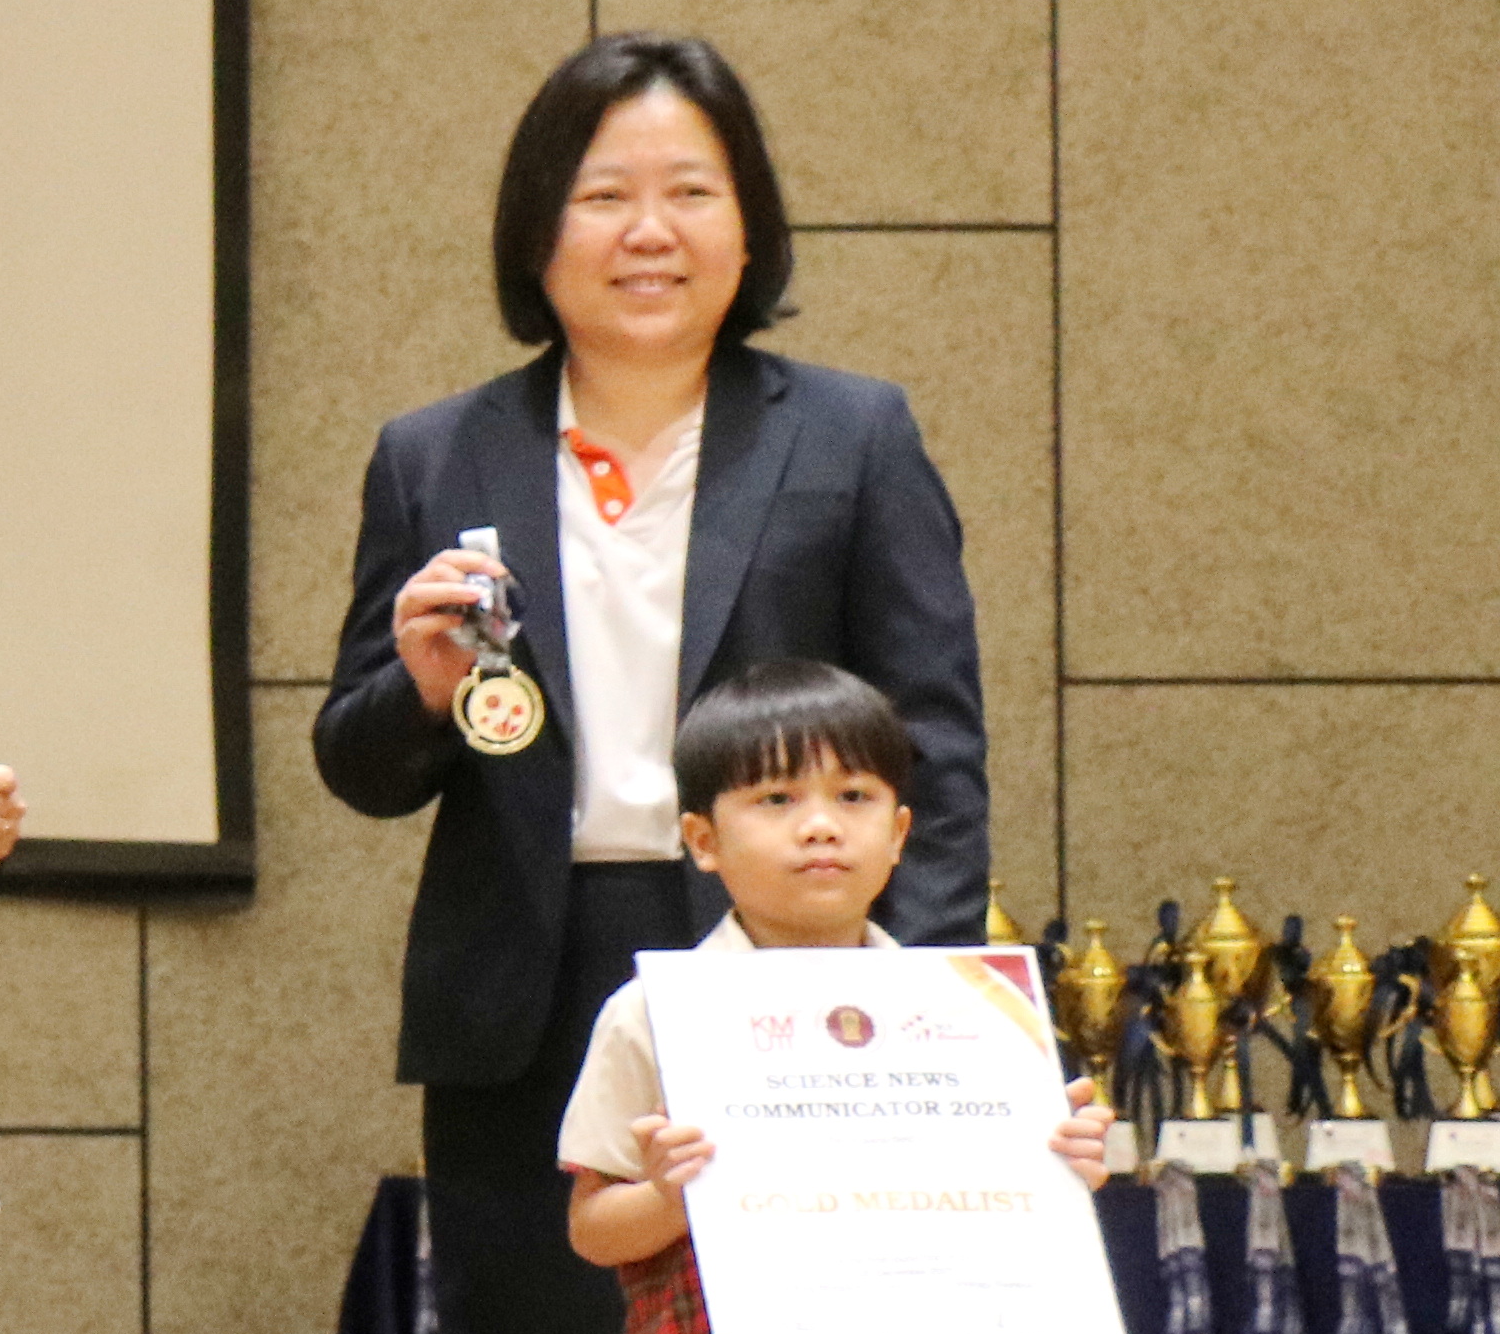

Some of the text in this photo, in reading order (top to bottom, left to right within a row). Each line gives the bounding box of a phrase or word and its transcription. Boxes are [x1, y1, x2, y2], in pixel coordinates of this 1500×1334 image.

[767, 1072, 958, 1088] SCIENCE NEWS
[726, 1101, 1011, 1117] COMMUNICATOR 2025
[739, 1190, 1032, 1213] GOLD MEDALIST
